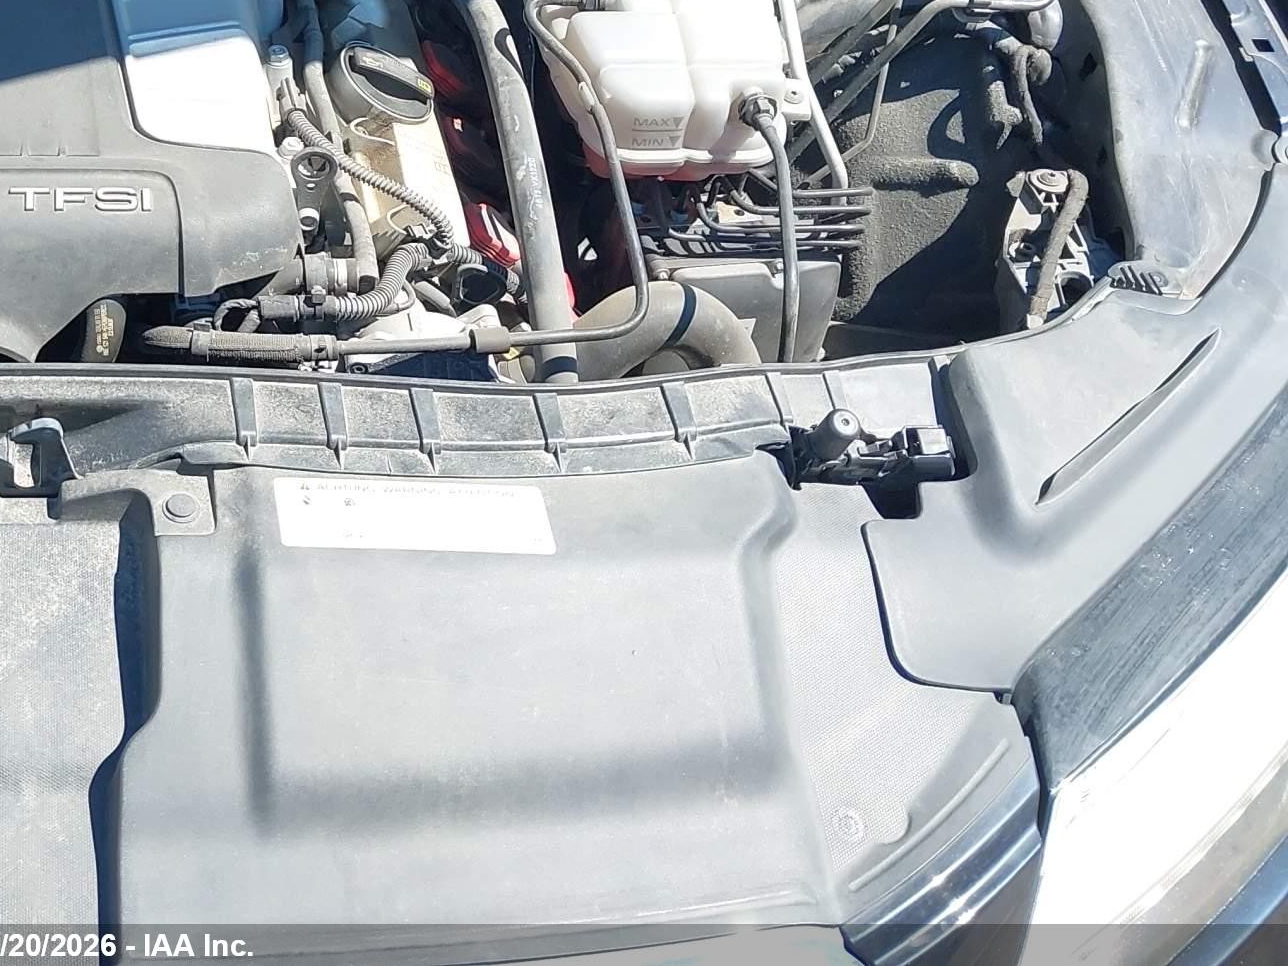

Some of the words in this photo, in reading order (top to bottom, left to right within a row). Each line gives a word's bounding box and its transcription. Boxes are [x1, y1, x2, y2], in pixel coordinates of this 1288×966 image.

[632, 117, 671, 128] MAX
[631, 137, 664, 147] MIN
[7, 186, 153, 213] TFSI
